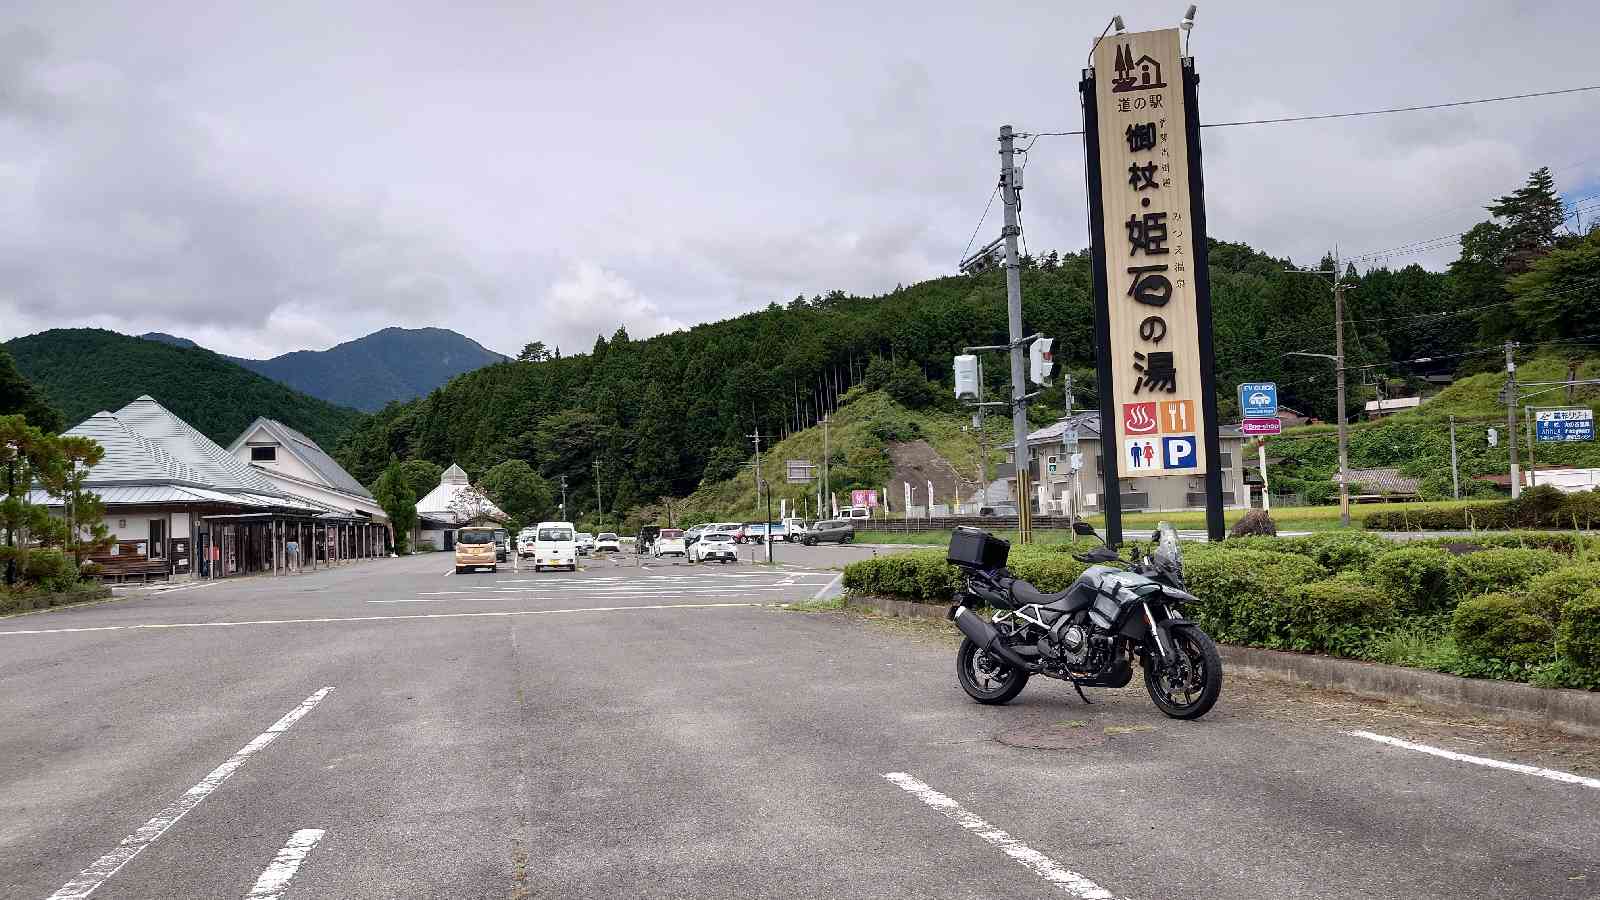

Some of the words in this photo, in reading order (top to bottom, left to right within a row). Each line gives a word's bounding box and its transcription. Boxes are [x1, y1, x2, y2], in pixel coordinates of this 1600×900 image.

[1118, 94, 1164, 113] 道の駅
[1172, 211, 1185, 289] みつえ温泉
[1168, 438, 1193, 466] P
